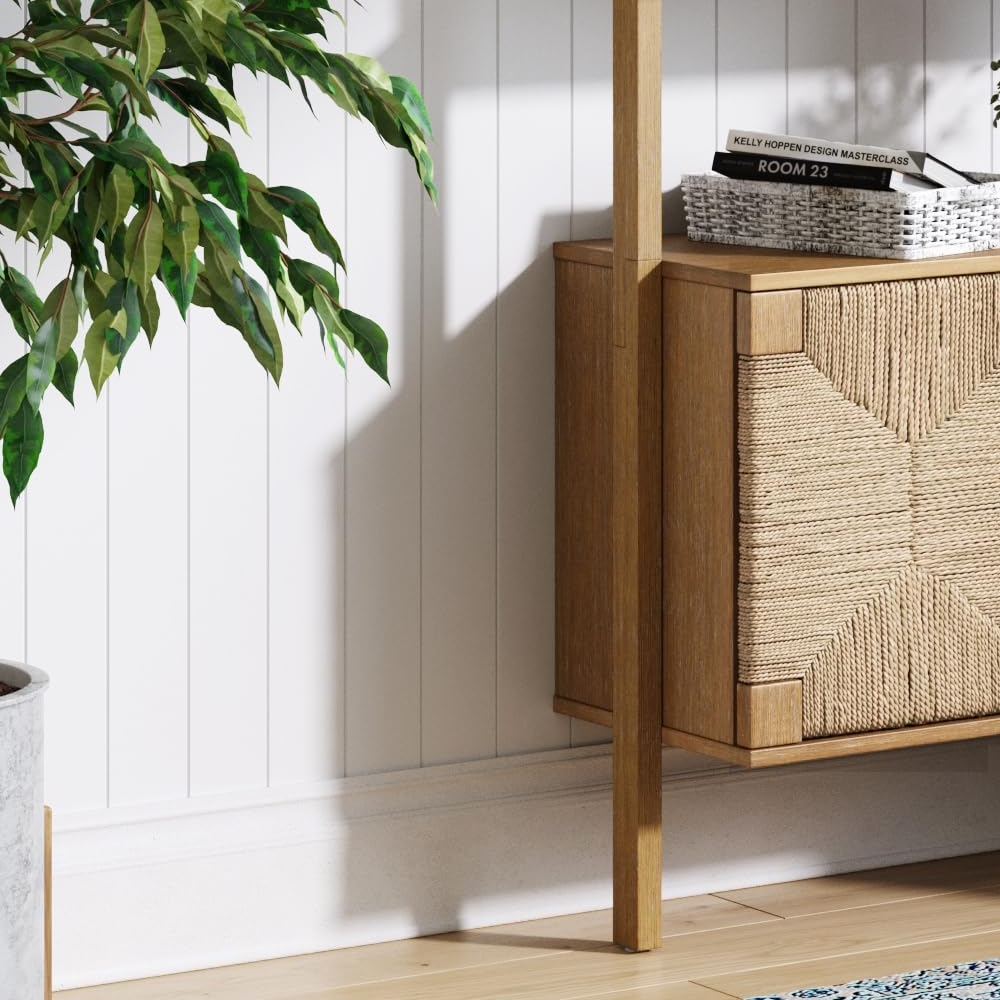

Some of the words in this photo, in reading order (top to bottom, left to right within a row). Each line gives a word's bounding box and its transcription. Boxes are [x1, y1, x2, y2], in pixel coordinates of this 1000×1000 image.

[733, 136, 763, 147] KELLY
[764, 139, 802, 152] HOPPEN
[804, 144, 838, 157] DESIGN
[840, 149, 910, 166] MASTERCLASS
[758, 160, 806, 177] ROOM
[809, 164, 829, 178] 23
